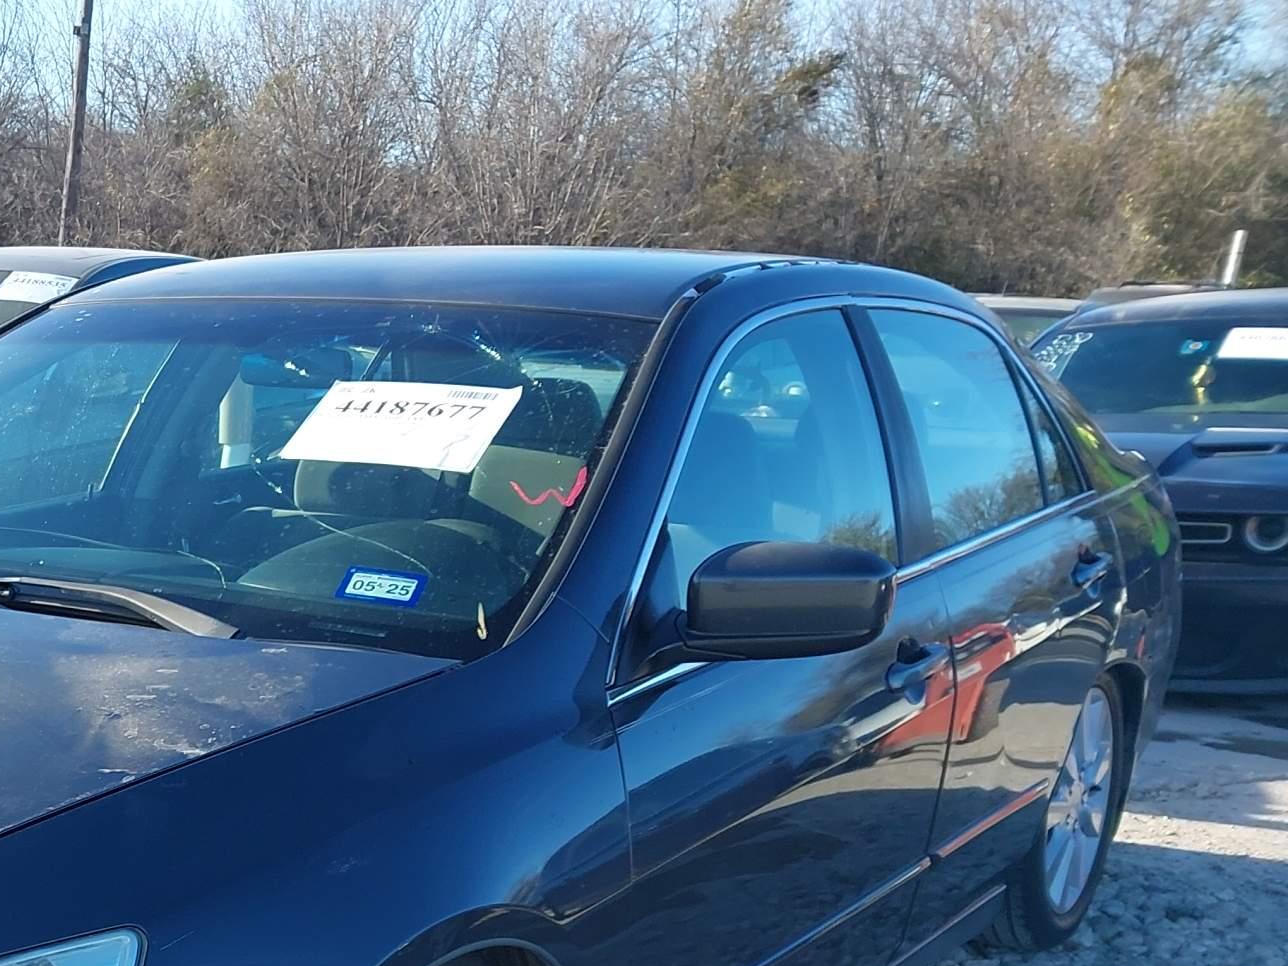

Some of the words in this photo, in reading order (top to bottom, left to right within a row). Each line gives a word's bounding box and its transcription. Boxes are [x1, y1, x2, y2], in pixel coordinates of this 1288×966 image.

[335, 400, 487, 420] 44187677
[352, 579, 377, 592] 05
[385, 583, 412, 596] 25
